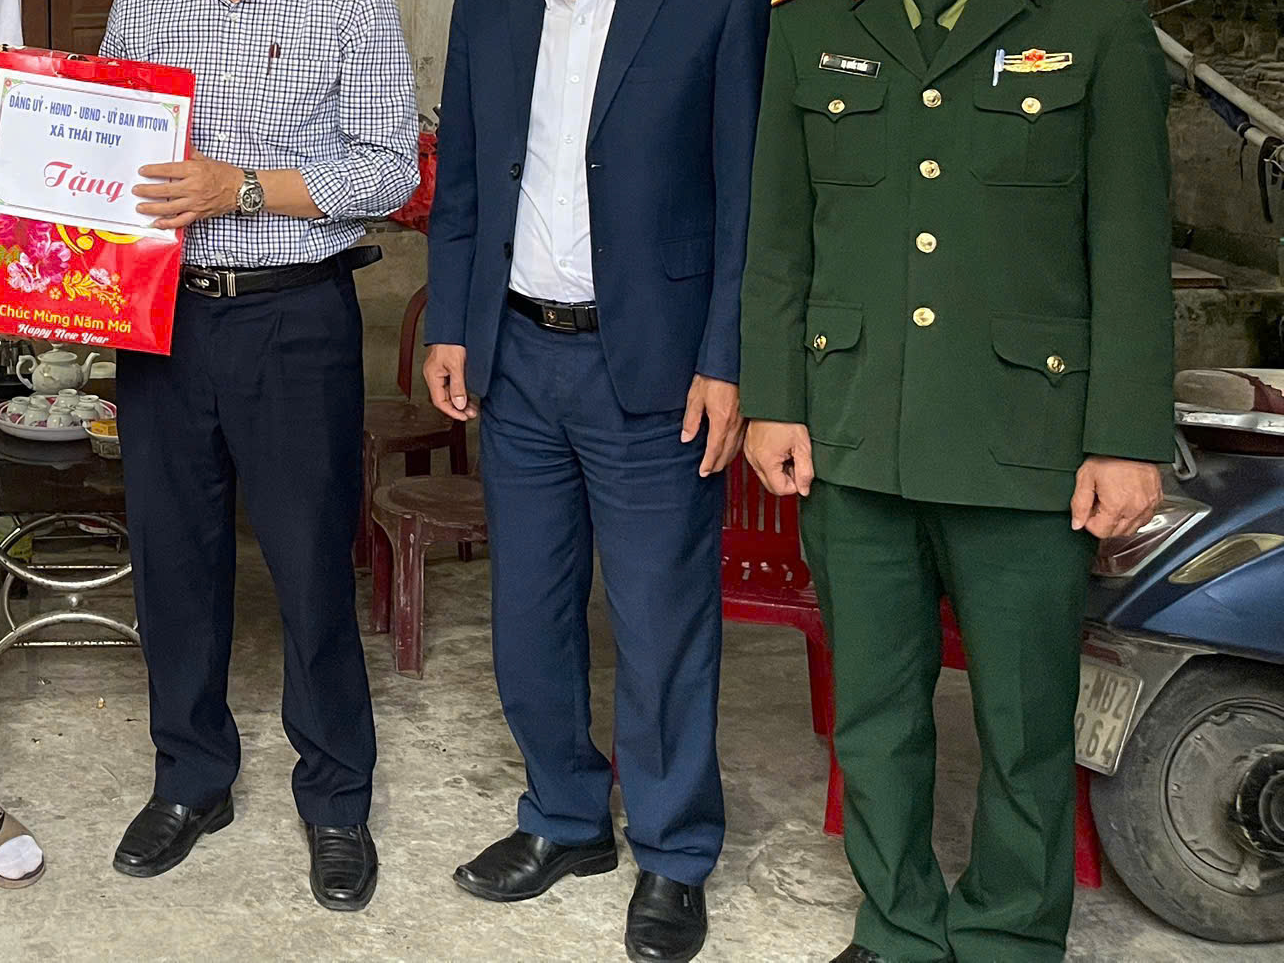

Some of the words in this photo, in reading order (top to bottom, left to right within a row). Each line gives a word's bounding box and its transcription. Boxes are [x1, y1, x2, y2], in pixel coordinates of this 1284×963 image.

[9, 92, 31, 110] ĐẢNG
[79, 106, 101, 122] UBND
[119, 112, 135, 127] BAN
[136, 115, 169, 132] MTTQVN
[50, 123, 64, 138] XÃ
[68, 127, 92, 142] THÁI
[96, 131, 121, 148] THỤY
[44, 161, 124, 203] Tặng
[33, 308, 70, 327] Mừng
[73, 315, 104, 330] Năm
[107, 319, 132, 333] Mới
[17, 323, 53, 339] Happy
[53, 328, 79, 340] New
[80, 332, 109, 344] Year
